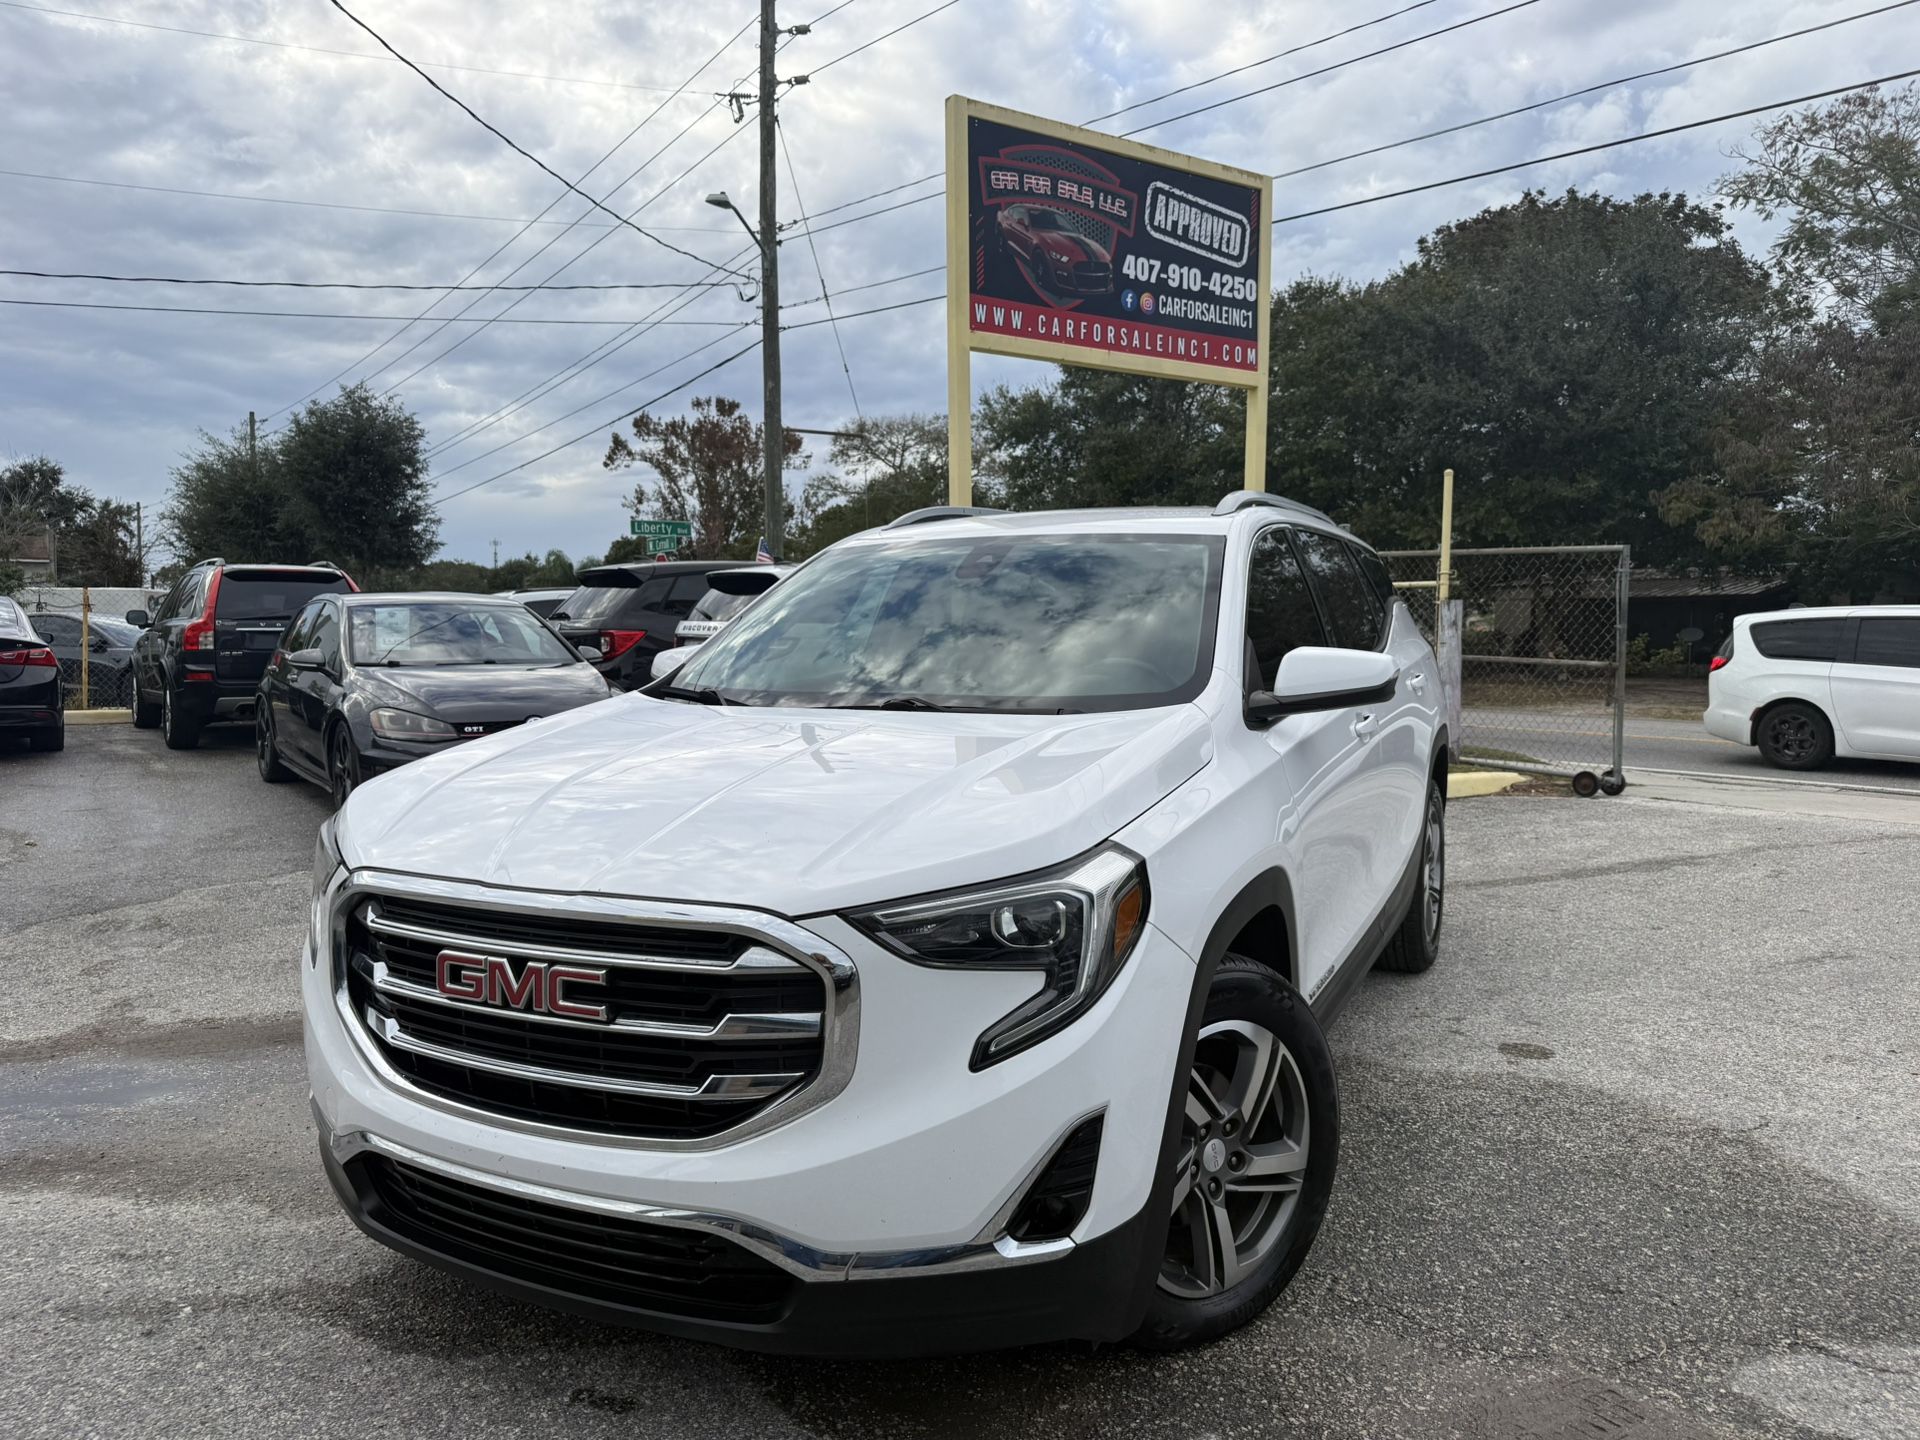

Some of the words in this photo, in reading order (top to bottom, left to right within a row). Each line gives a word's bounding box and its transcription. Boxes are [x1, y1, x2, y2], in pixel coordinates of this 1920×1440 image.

[991, 170, 1019, 190] CAR
[1024, 174, 1051, 195] FOR
[1058, 180, 1094, 208] SALE,
[1153, 194, 1242, 257] APPROVED
[1122, 254, 1257, 302] 407-910-4250
[975, 303, 1257, 364] WWW.CARFORSALEINC1.COM
[1158, 295, 1253, 328] CARFORSALEINC1
[634, 521, 672, 536] Liberty
[436, 949, 607, 1022] GMC
